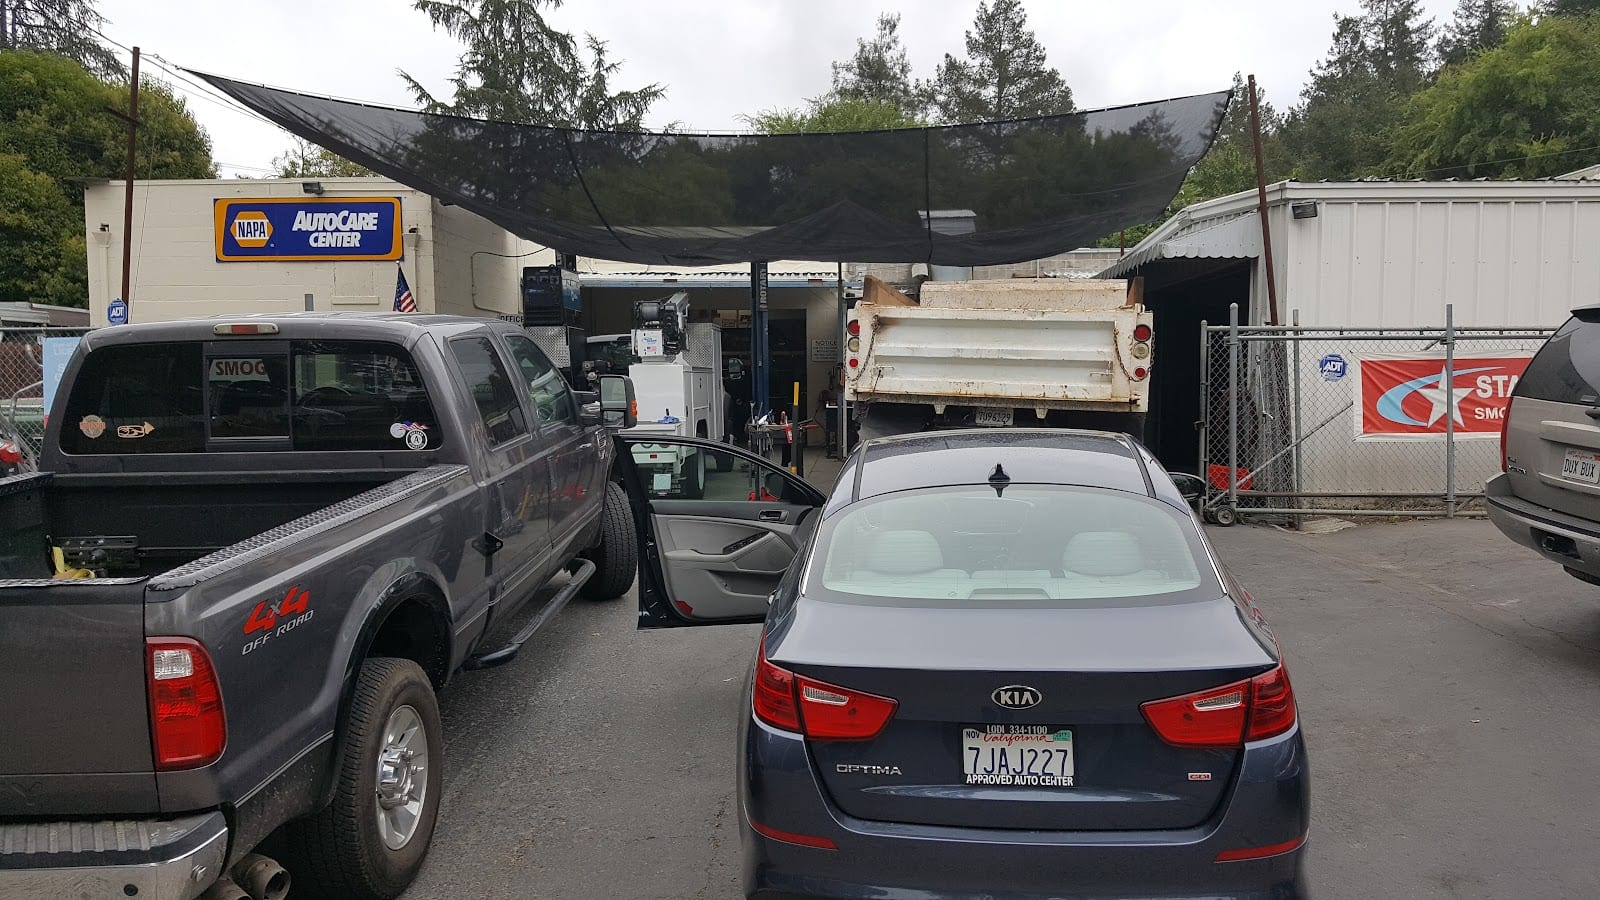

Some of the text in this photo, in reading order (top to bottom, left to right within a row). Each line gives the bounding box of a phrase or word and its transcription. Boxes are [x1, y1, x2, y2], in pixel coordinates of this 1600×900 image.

[237, 221, 266, 238] NAPA
[308, 231, 361, 247] CENTER
[110, 306, 124, 317] ADT
[215, 361, 267, 375] SMOG
[1322, 361, 1343, 372] ADT
[1563, 458, 1596, 478] DUX BUX
[242, 610, 314, 655] OFF ROAD
[1000, 691, 1034, 705] KIA
[966, 731, 980, 739] NOV
[986, 725, 1048, 735] LODI 334-1100
[983, 732, 1054, 746] California
[968, 747, 1068, 776] 7JAJ227
[836, 764, 902, 775] OPTIMA
[966, 774, 1074, 786] APPROVED AUTO CENTER
